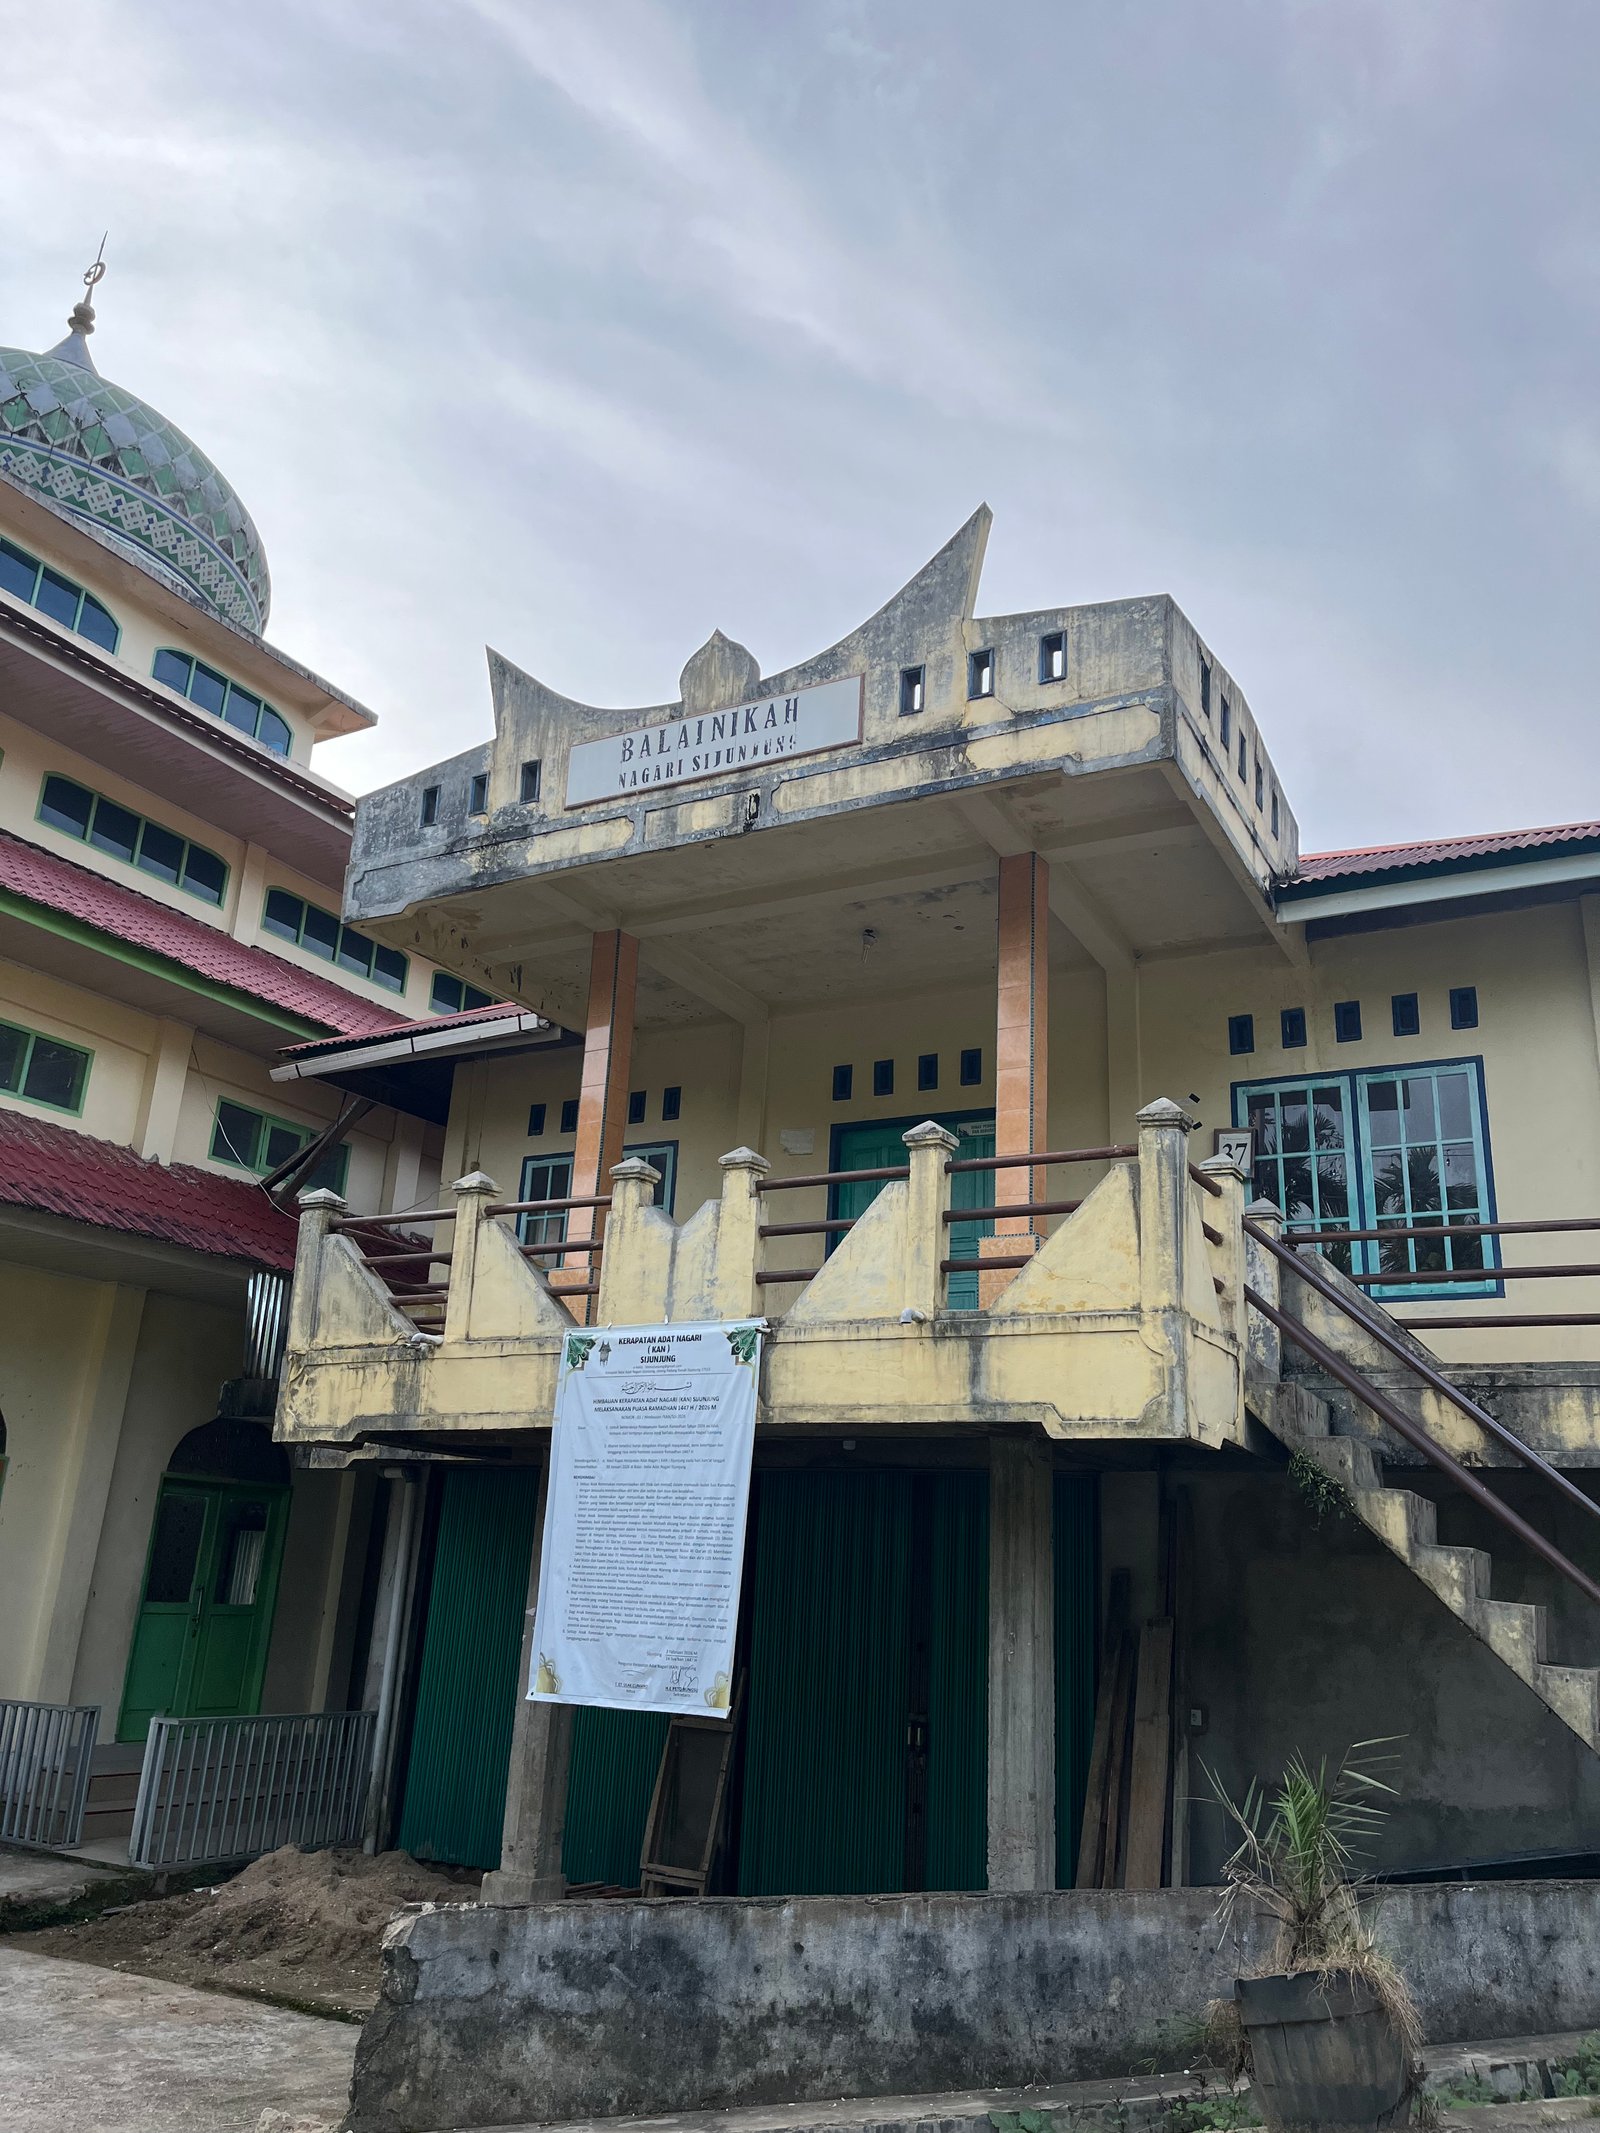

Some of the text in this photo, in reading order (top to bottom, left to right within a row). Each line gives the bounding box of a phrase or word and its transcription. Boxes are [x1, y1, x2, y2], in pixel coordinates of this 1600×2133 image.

[1222, 1142, 1248, 1166] 37
[618, 1334, 702, 1345] KERAPATAN ADAT NAGARI
[640, 1355, 676, 1364] SIJUNJUNG
